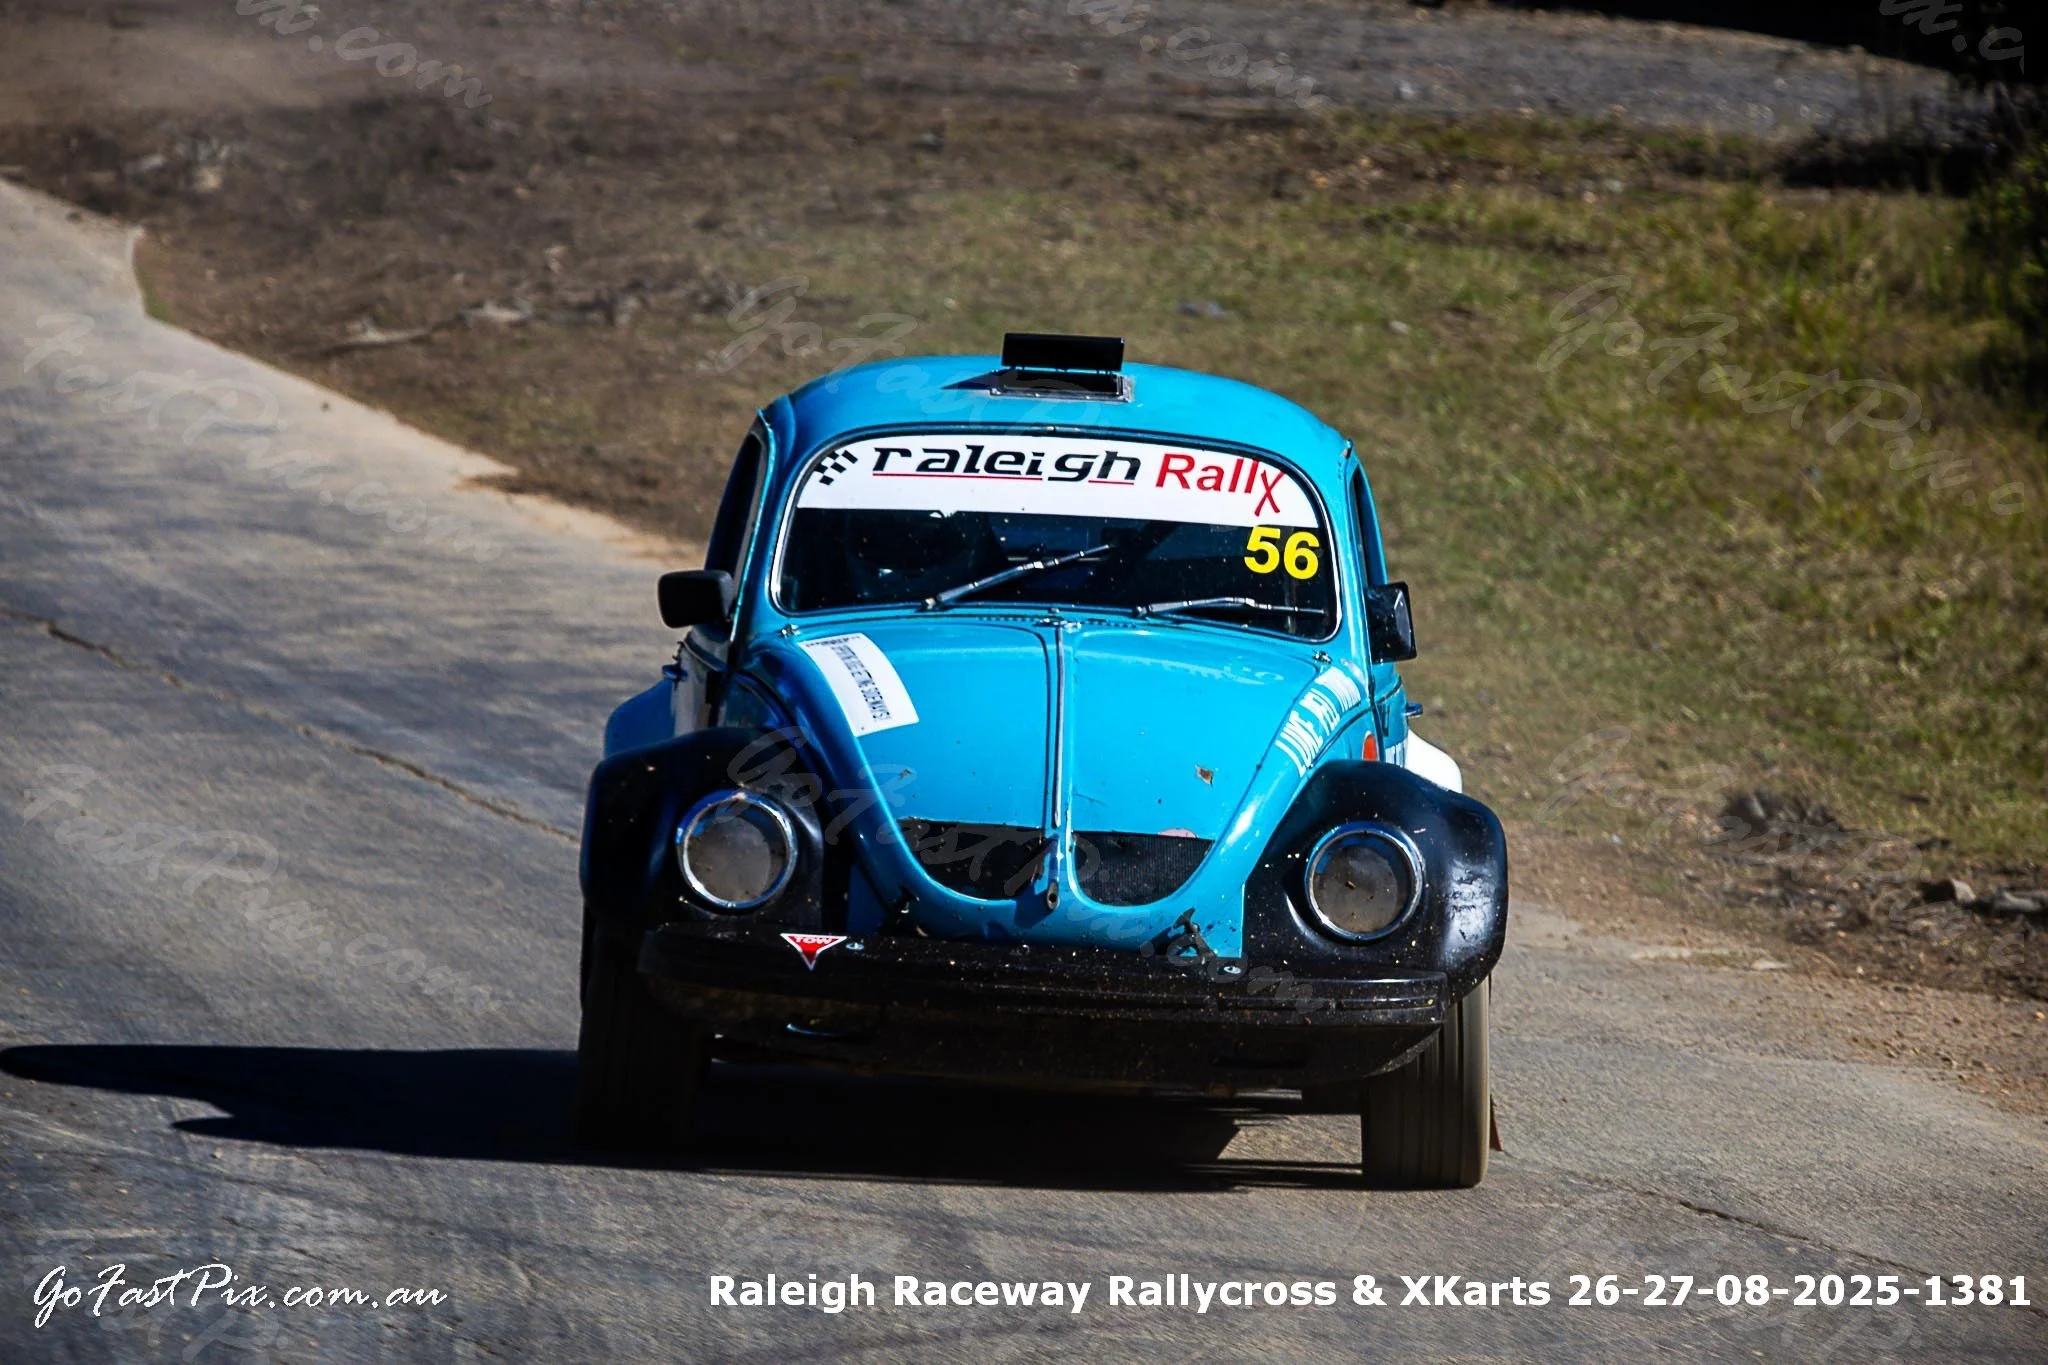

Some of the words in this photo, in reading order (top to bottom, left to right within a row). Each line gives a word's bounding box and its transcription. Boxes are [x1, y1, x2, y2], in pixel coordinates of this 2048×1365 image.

[872, 445, 1142, 483] raleigh
[1243, 524, 1321, 580] 56
[794, 935, 833, 945] TOW
